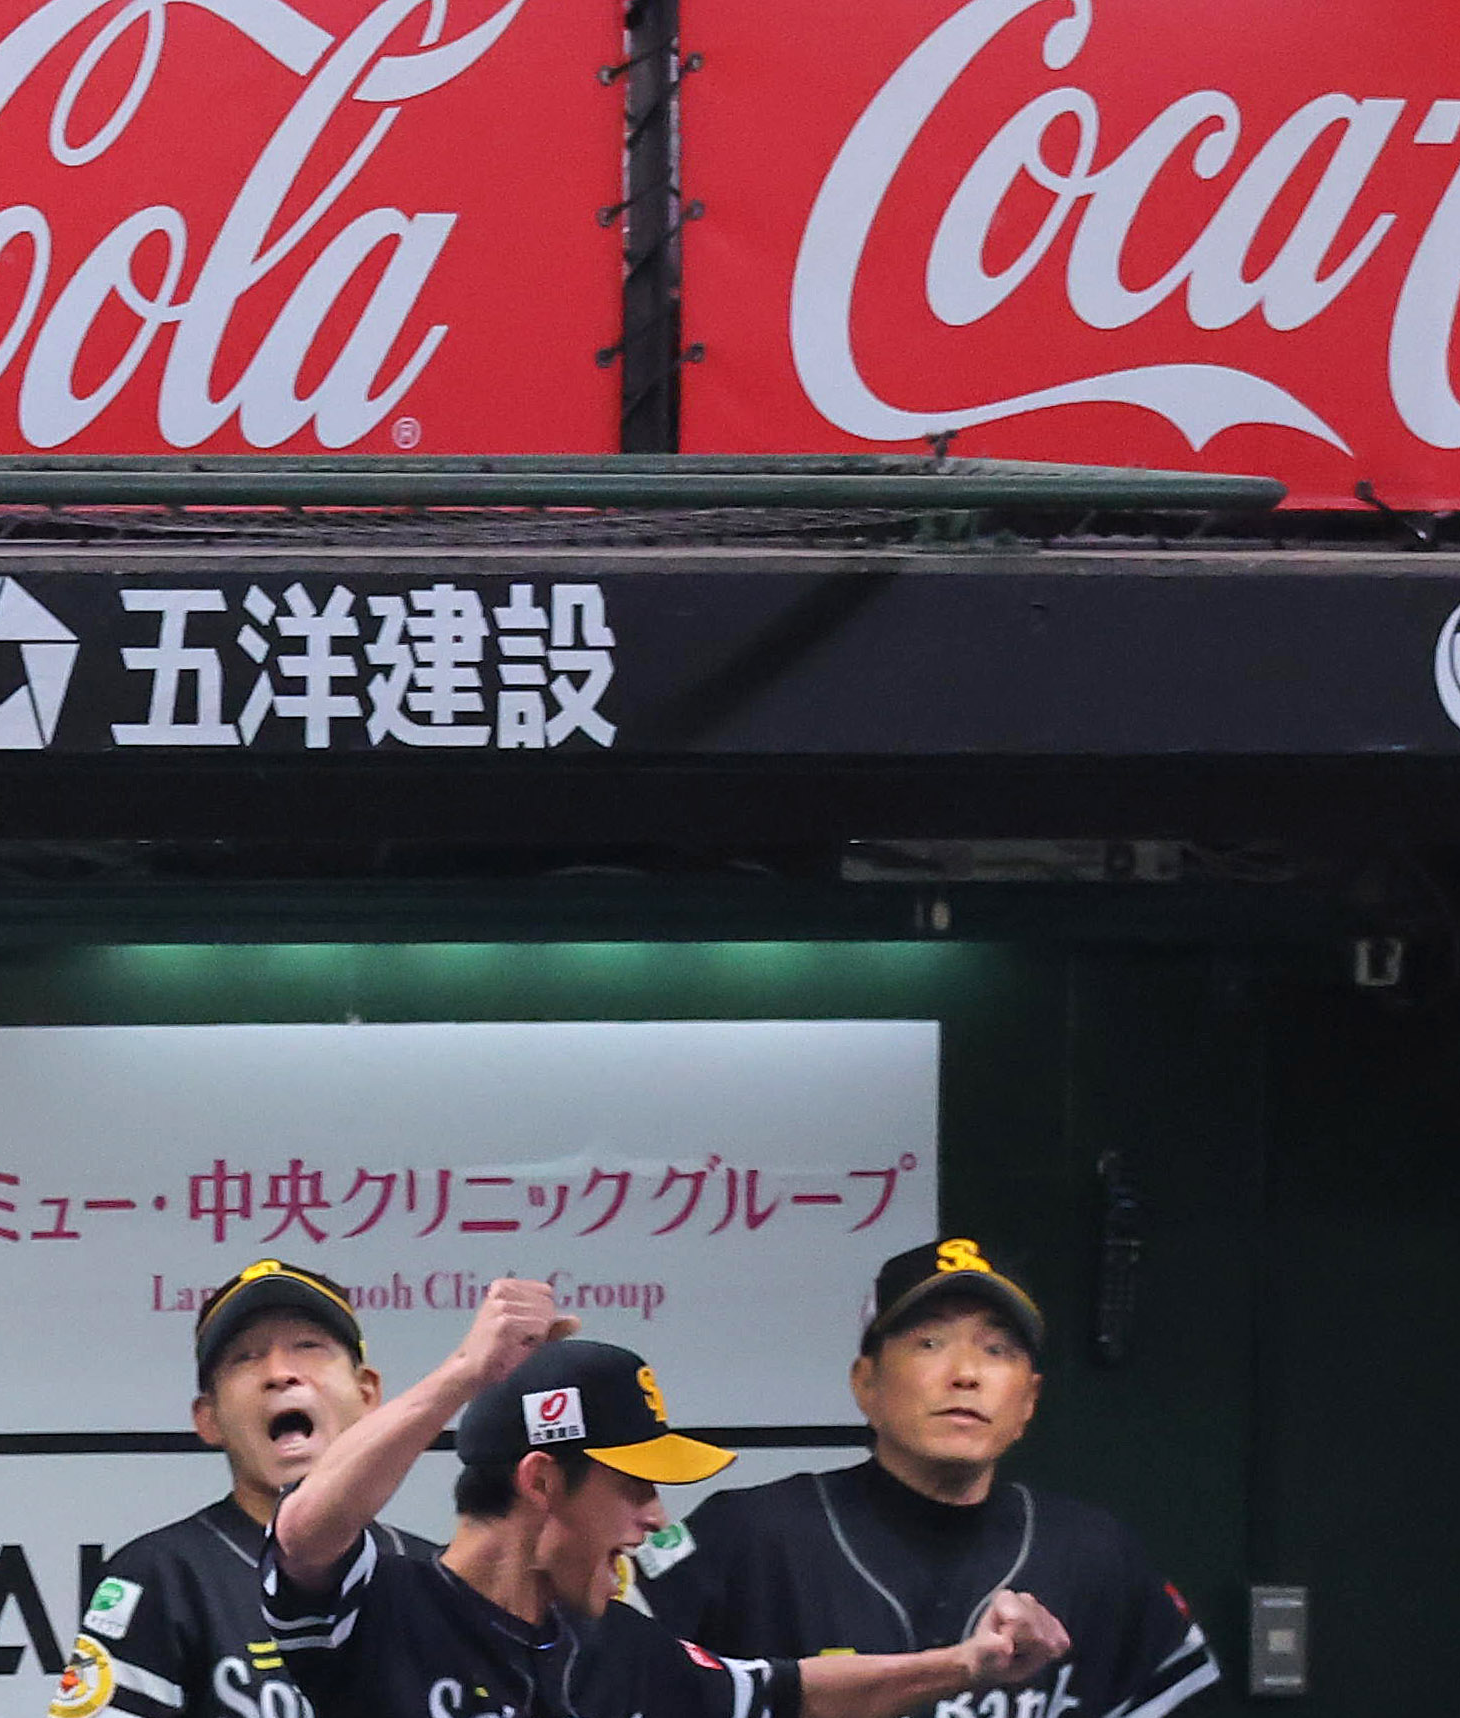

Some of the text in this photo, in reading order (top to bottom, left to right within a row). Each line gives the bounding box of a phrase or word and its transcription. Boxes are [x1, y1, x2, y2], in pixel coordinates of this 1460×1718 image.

[790, 0, 1460, 455] Coca-
[110, 583, 616, 752] 五洋建設
